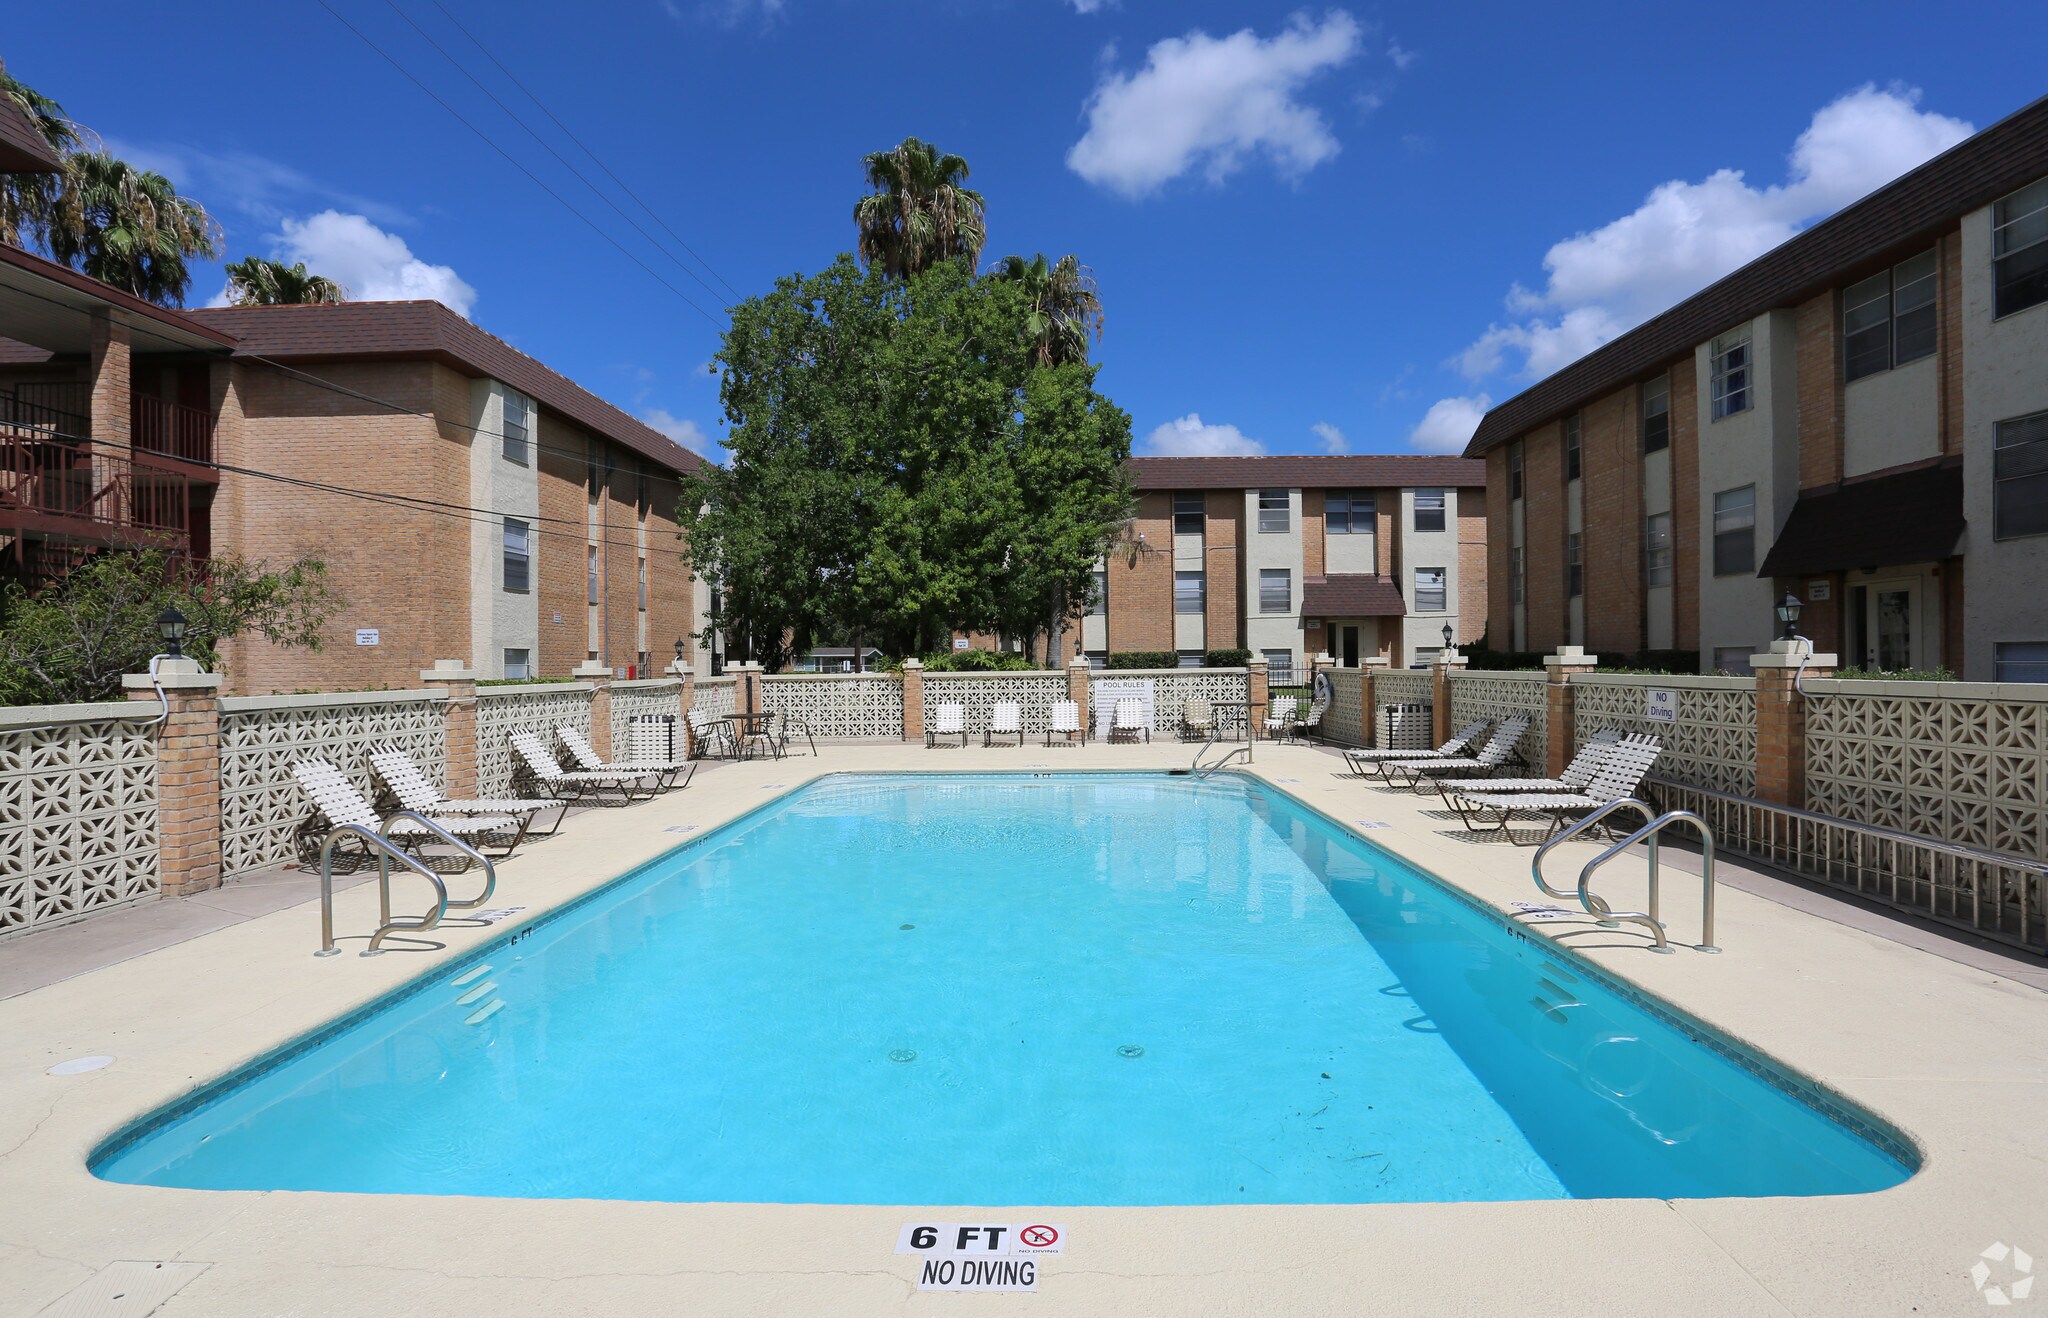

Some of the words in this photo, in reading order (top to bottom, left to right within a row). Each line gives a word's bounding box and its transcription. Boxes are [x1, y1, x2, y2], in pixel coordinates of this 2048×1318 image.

[1656, 692, 1667, 702] NO
[1651, 706, 1672, 719] Diving
[910, 1226, 938, 1249] 6
[956, 1227, 1007, 1250] FT
[922, 1260, 955, 1285] NO
[961, 1261, 1035, 1286] DIVING
